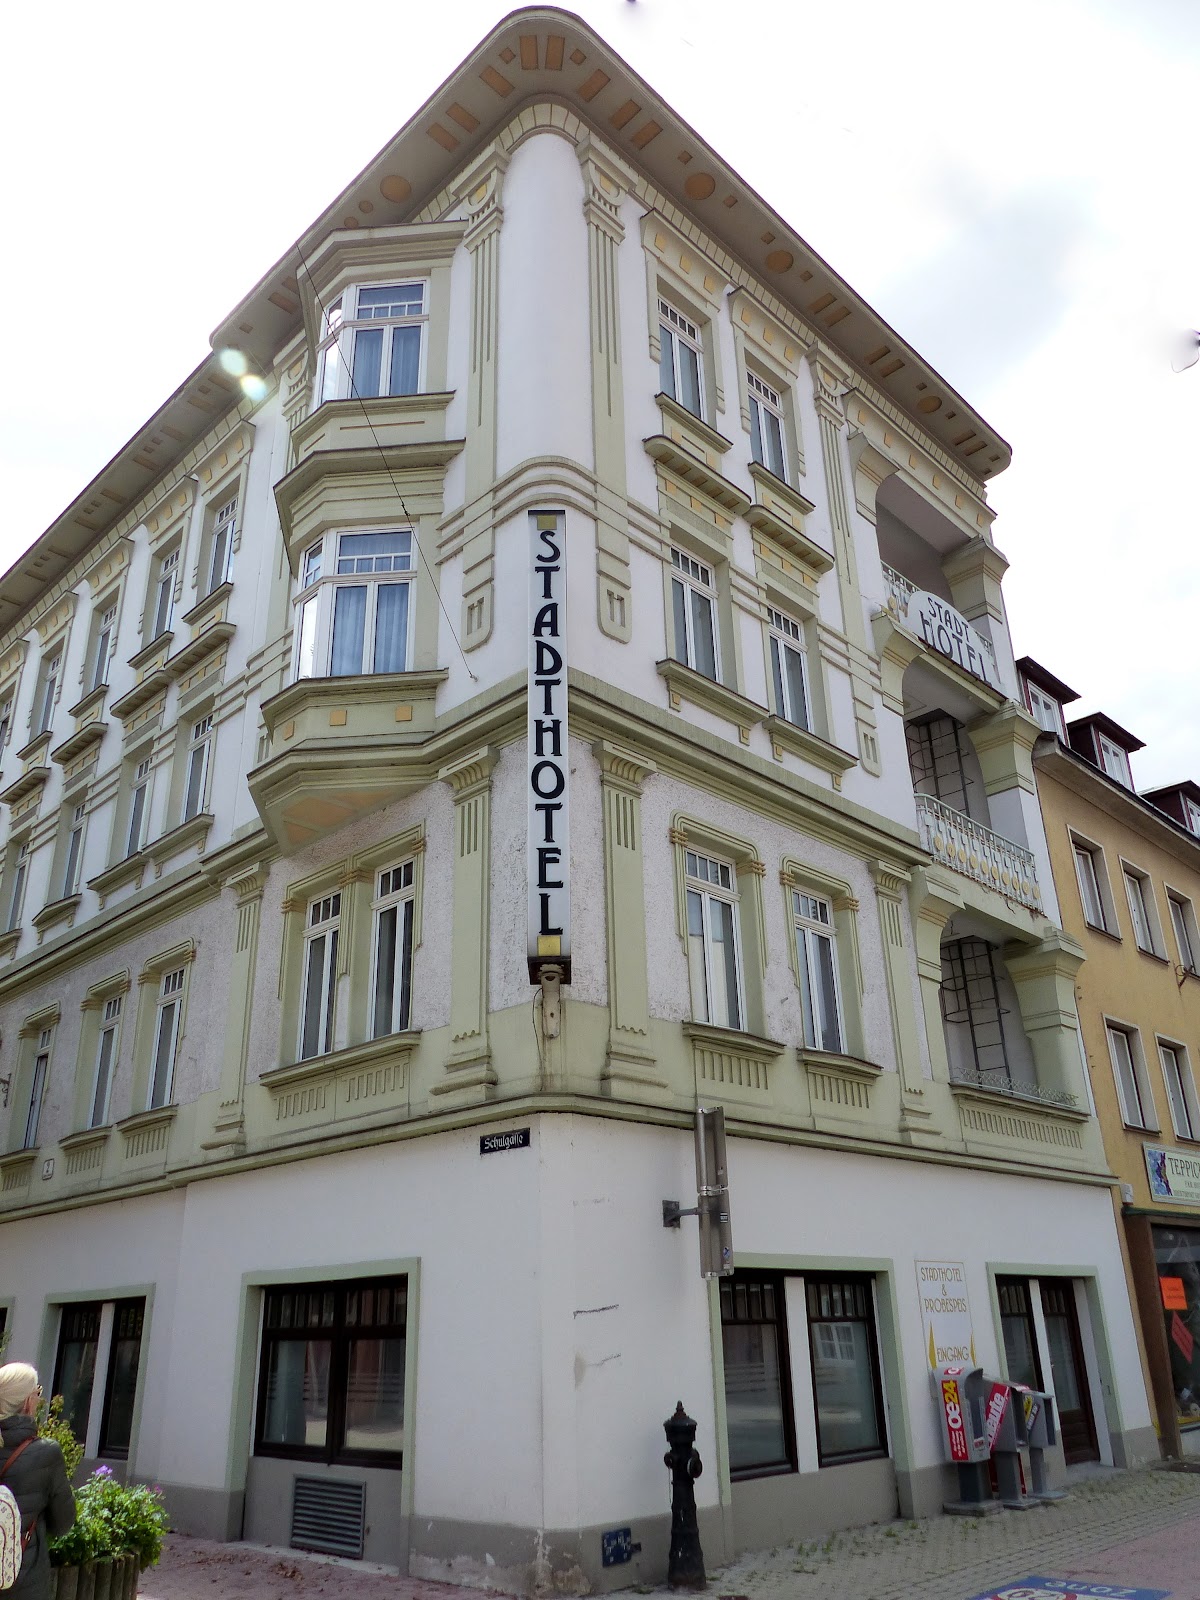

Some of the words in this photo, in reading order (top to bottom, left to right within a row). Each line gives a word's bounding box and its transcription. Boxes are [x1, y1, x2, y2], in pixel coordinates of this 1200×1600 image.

[927, 597, 970, 643] STADT
[919, 610, 993, 687] HOTEL
[531, 530, 565, 936] STADTHOTEL
[1168, 1157, 1200, 1179] TEPPIC
[920, 1266, 962, 1281] STADTHOTEL
[941, 1284, 947, 1296] &
[937, 1346, 969, 1362] EINGANG
[943, 1380, 962, 1429] oe24
